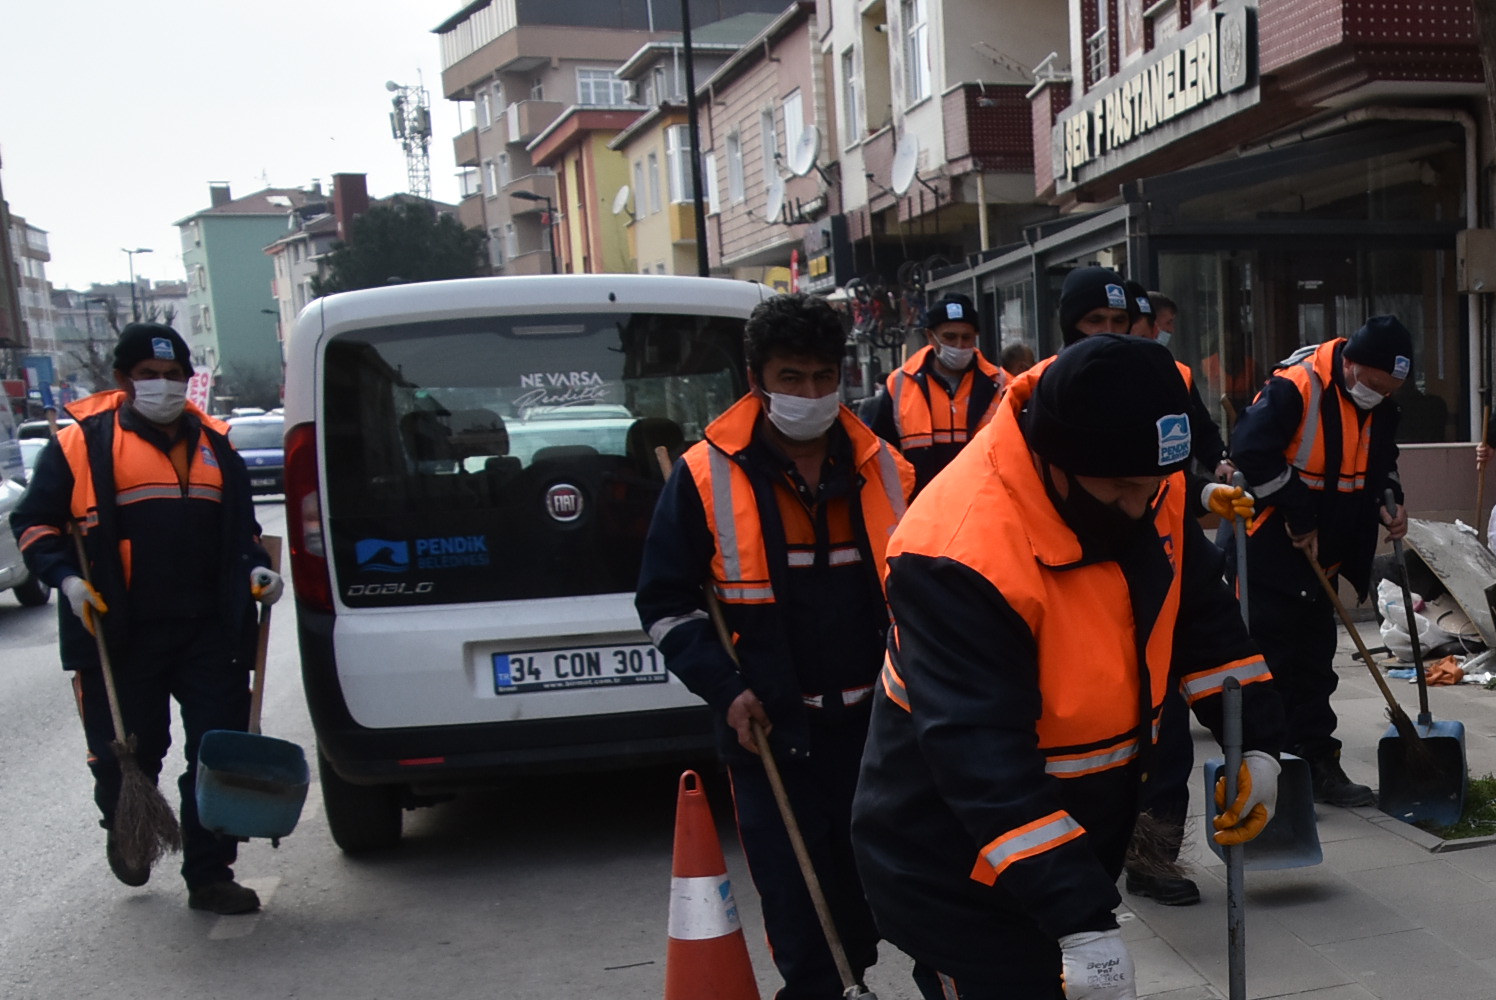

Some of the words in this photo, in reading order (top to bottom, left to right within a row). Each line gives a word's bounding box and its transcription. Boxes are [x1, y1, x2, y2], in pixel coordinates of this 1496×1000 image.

[520, 373, 544, 388] NE
[546, 372, 604, 387] VARSA
[553, 494, 576, 512] FIAT
[347, 581, 435, 597] DOBLO
[510, 656, 541, 682] 34
[612, 648, 658, 675] 301
